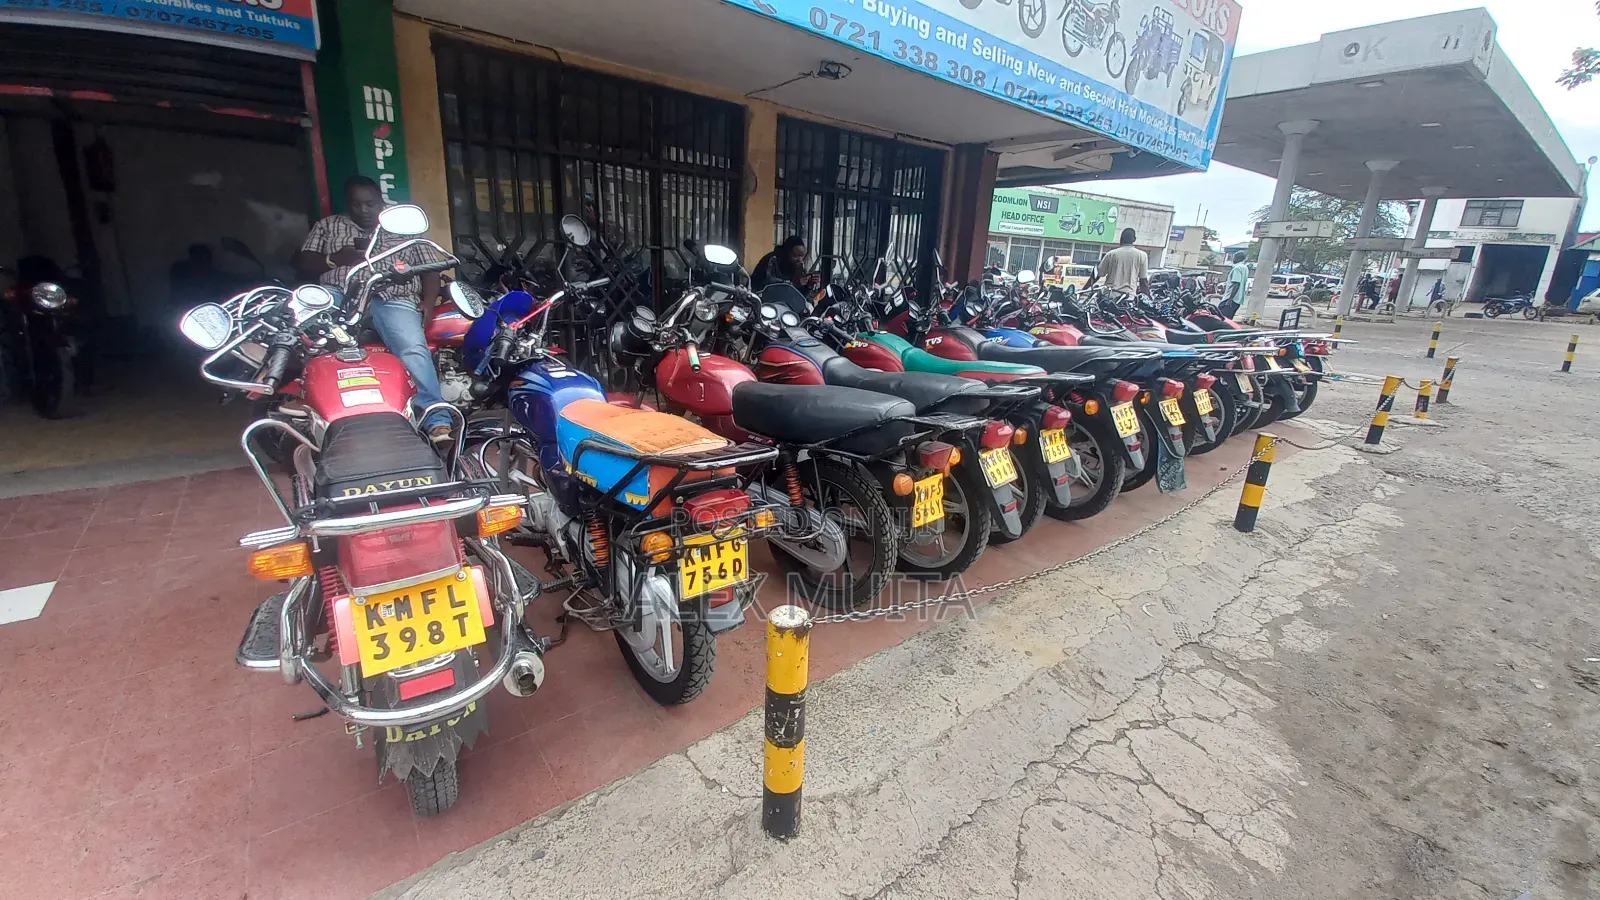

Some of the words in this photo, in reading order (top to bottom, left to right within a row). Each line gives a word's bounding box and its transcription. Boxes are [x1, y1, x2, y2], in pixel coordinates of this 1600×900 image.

[216, 6, 243, 19] and
[246, 9, 301, 30] Tuktuks
[809, 7, 881, 51] 0721
[892, 39, 938, 71] 338
[946, 59, 986, 88] 308
[862, 0, 931, 40] Buying
[935, 26, 968, 51] and
[972, 37, 1023, 76] Selling
[1027, 60, 1057, 85] New
[1060, 78, 1081, 96] and
[1083, 84, 1116, 111] Second
[993, 194, 1028, 207] ZOOMLION
[1036, 200, 1051, 210] NSI
[1001, 210, 1020, 221] HEAD
[1021, 213, 1045, 224] OFFICE
[925, 336, 943, 347] TVS
[342, 476, 433, 497] DAYUN
[686, 557, 742, 591] 756D
[364, 584, 467, 631] KMFL
[370, 612, 469, 661] 398T
